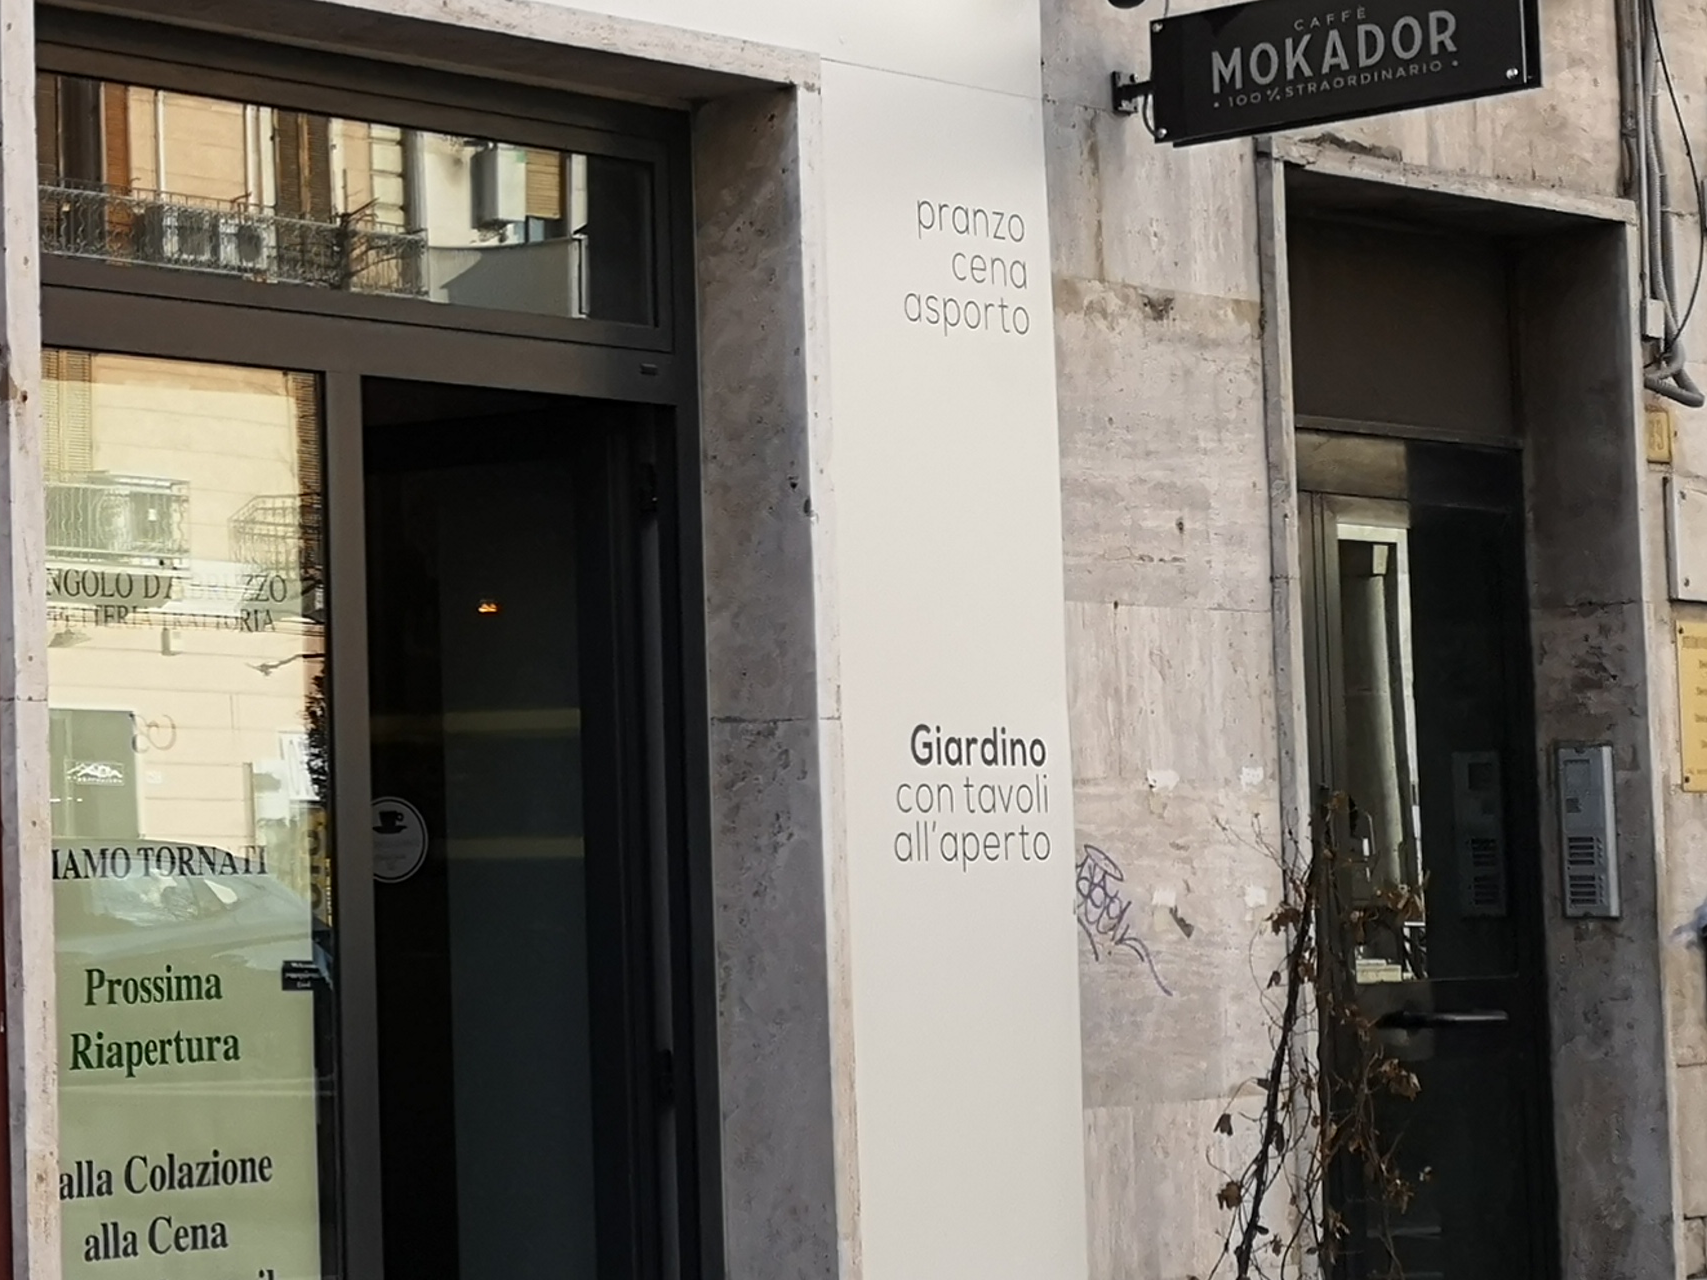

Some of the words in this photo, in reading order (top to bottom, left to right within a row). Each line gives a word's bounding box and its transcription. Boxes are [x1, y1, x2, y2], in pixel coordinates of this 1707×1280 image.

[1294, 4, 1367, 31] CAFFÈ
[1211, 11, 1457, 94] MOKADOR
[1228, 87, 1281, 108] 100%
[1286, 61, 1442, 98] STRAORDINARIO
[917, 200, 1024, 242] pranzo
[952, 252, 1026, 289] cena
[904, 293, 1030, 336] asporto
[911, 724, 1046, 766] Giardino
[897, 783, 953, 813] con
[963, 774, 1048, 813] tavoli
[137, 844, 268, 877] TORNATI
[895, 821, 1051, 872] all'aperto
[85, 964, 222, 1006] Prossima
[69, 1029, 240, 1078] Riapertura
[124, 1149, 272, 1194] Colazione
[84, 1222, 138, 1262] alla
[148, 1216, 228, 1254] Cena
